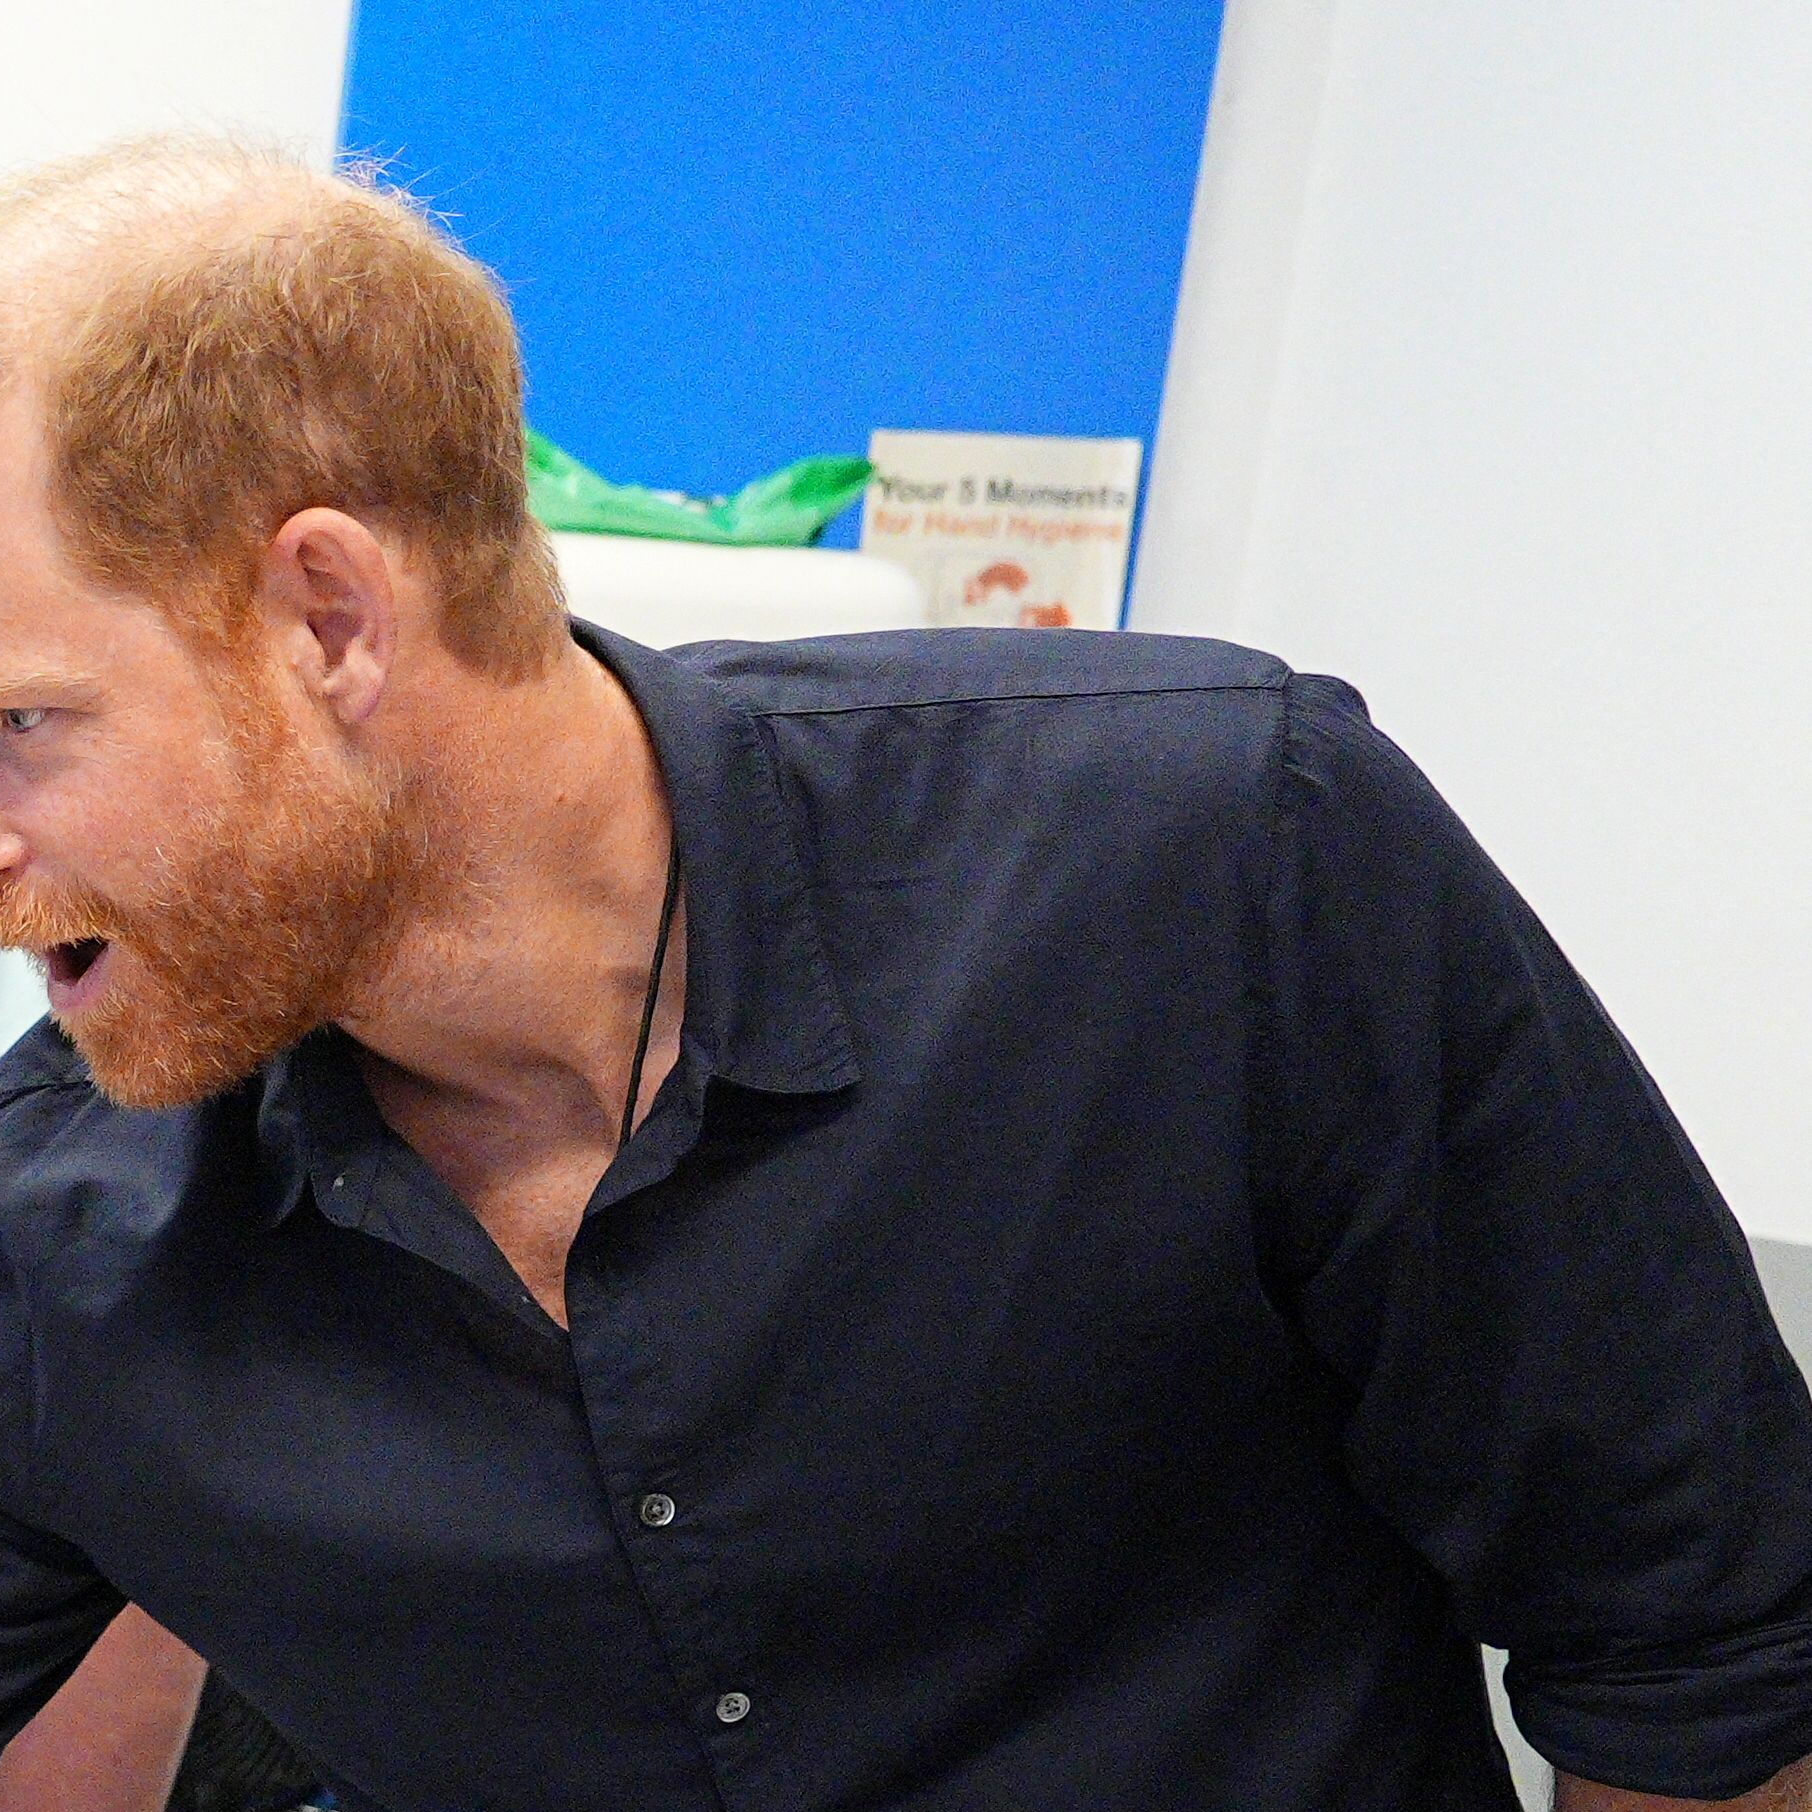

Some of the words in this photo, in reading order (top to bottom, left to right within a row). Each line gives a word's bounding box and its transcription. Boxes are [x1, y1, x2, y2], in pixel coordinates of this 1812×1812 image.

[878, 476, 949, 502] Your
[960, 478, 975, 504] 5
[986, 478, 1129, 508] Moments
